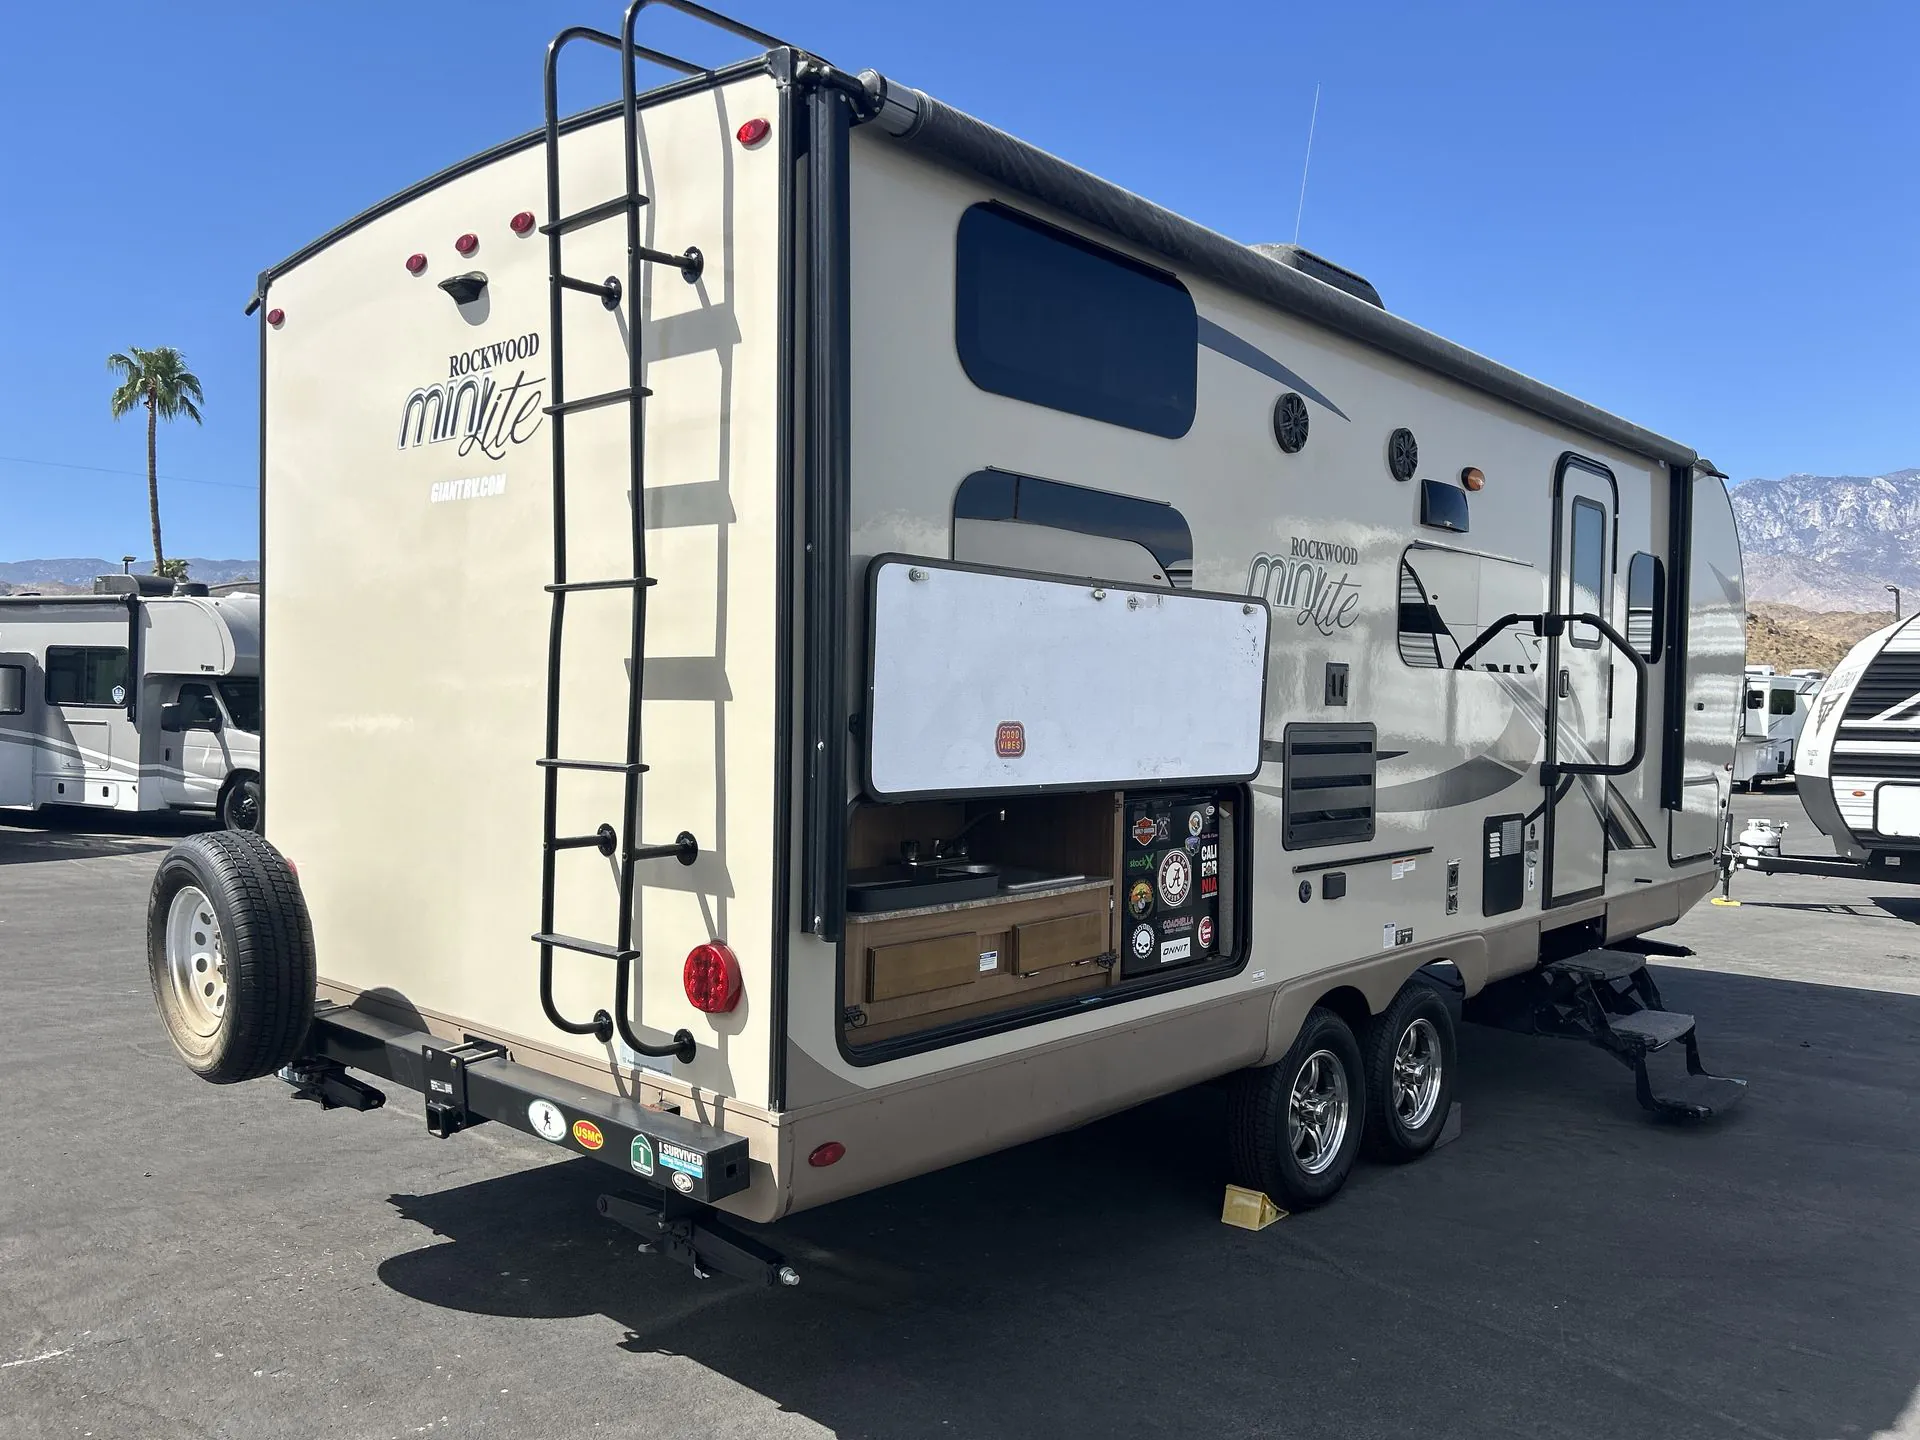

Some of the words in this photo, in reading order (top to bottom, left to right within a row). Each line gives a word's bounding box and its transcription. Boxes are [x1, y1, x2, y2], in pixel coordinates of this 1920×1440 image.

[449, 332, 540, 378] ROCKWOOD
[431, 473, 507, 503] GIANTRV.COM
[1290, 536, 1359, 566] ROCKWOOD
[1000, 740, 1021, 750] VIBES
[1201, 844, 1217, 861] CALI
[1162, 855, 1188, 876] ALABAMA
[1169, 866, 1181, 889] A
[1201, 876, 1217, 893] NIA
[1162, 916, 1194, 929] COACHELLA
[1162, 943, 1188, 955] ONNIT
[575, 1125, 601, 1144] USMC
[639, 1147, 645, 1164] 1
[659, 1142, 662, 1153] I
[663, 1143, 703, 1166] SURVIVED
